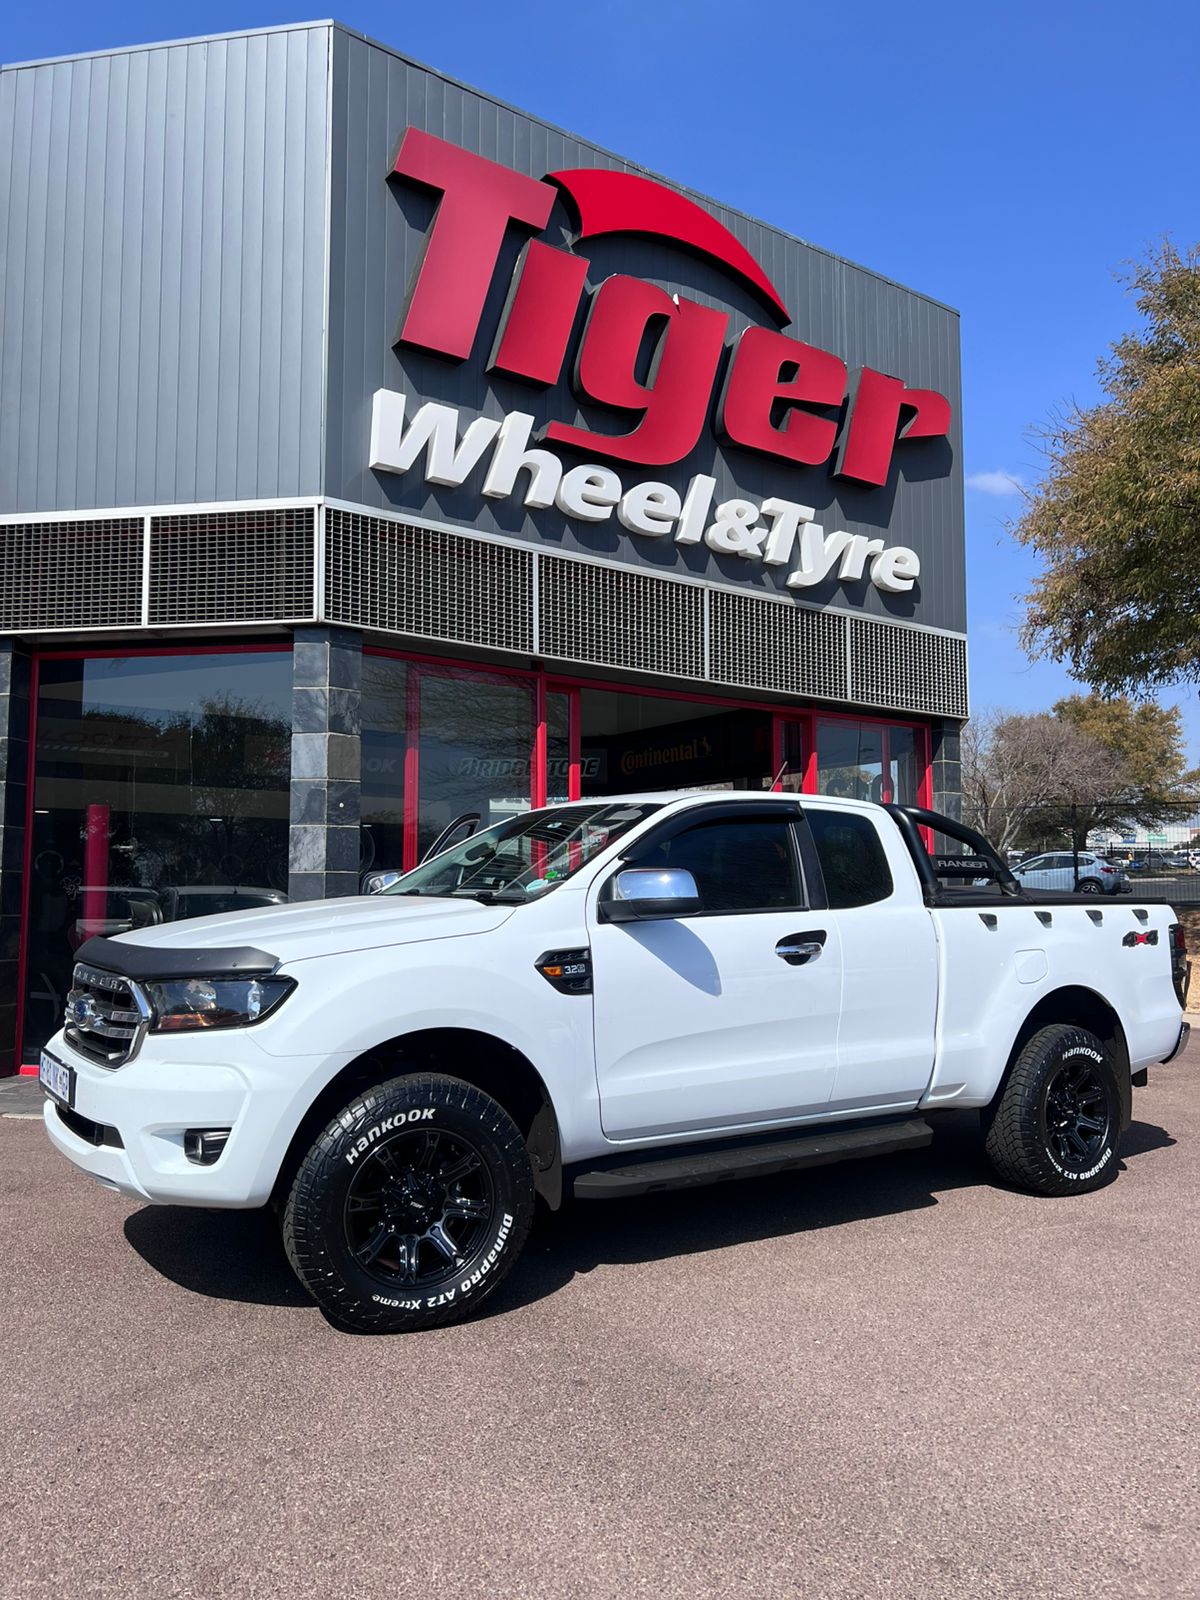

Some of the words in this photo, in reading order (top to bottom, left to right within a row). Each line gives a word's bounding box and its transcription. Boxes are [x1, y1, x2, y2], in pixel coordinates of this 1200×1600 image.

[386, 125, 951, 488] Tiger
[618, 738, 698, 776] Continental
[459, 757, 600, 778] BRIDGETOE
[937, 860, 989, 869] RANGER
[371, 1293, 423, 1310] Xtreme
[426, 1288, 457, 1308] AT2
